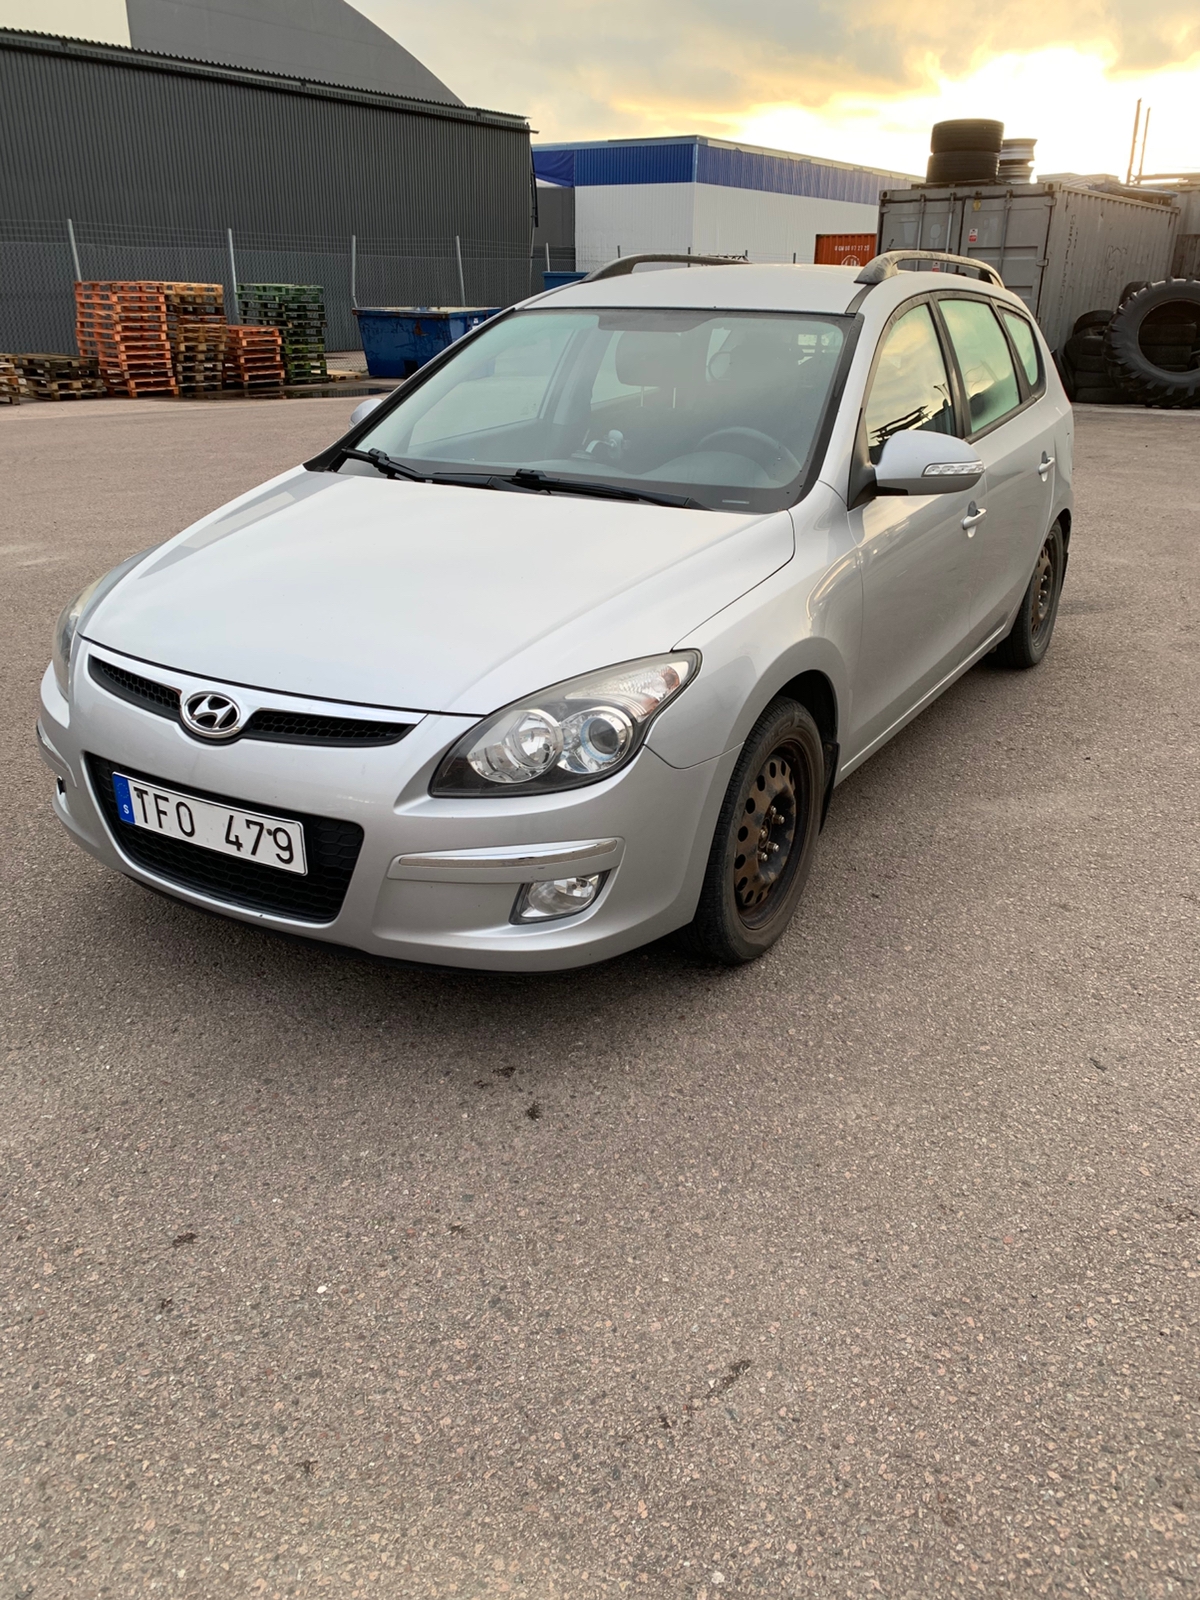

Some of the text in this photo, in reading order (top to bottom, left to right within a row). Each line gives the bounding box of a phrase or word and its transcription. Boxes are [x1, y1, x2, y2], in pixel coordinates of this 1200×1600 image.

[122, 803, 130, 815] S
[133, 786, 294, 865] TFO 479
